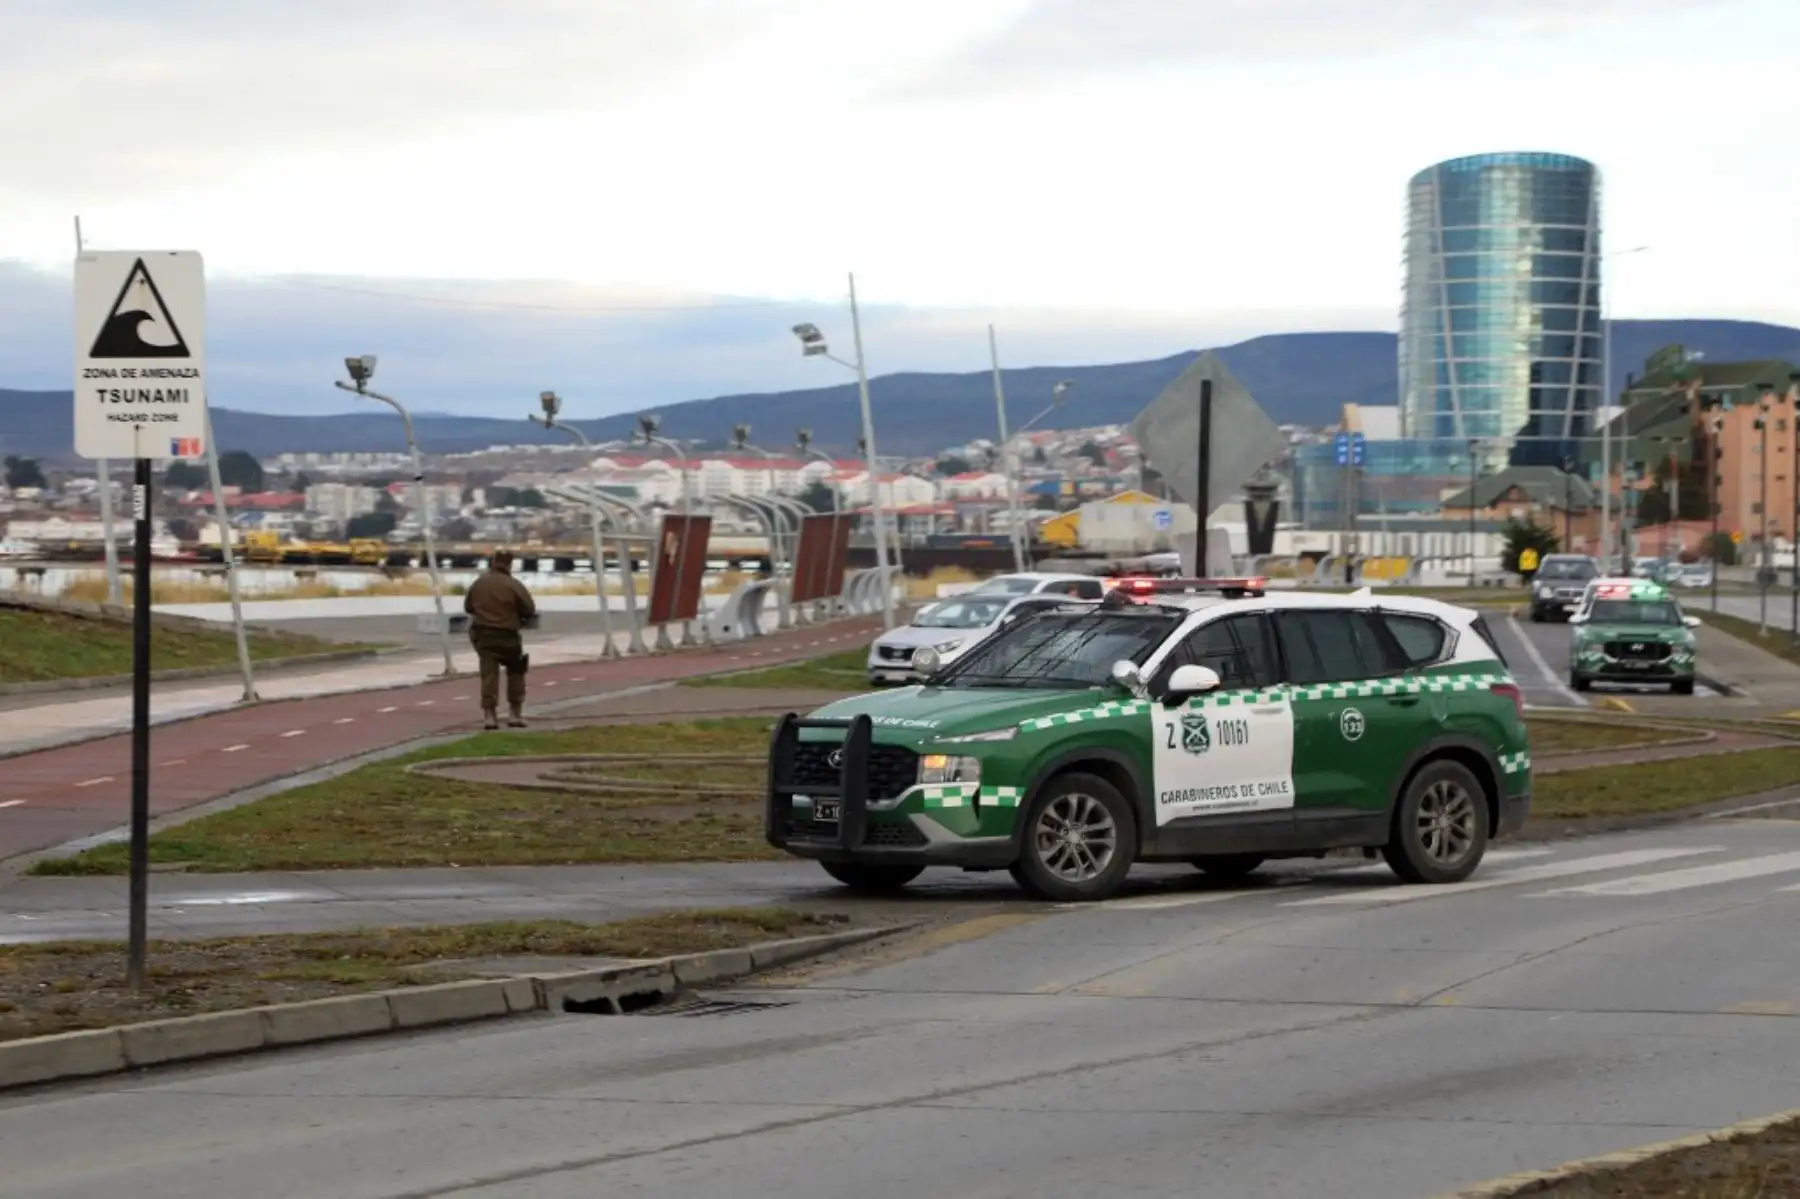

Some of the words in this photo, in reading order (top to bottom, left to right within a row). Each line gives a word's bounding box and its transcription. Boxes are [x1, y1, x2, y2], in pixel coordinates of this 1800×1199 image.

[83, 368, 119, 378] ZONA
[121, 368, 138, 378] DE
[140, 368, 200, 378] AMENAZA
[96, 388, 189, 403] TSUNAMI
[106, 413, 149, 422] HAZARD
[151, 413, 179, 422] ZONE
[1165, 722, 1177, 750] Z
[1216, 718, 1249, 746] 10161
[1160, 785, 1238, 805] CARABINEROS
[1240, 783, 1255, 798] DE
[1257, 780, 1289, 796] CHILE
